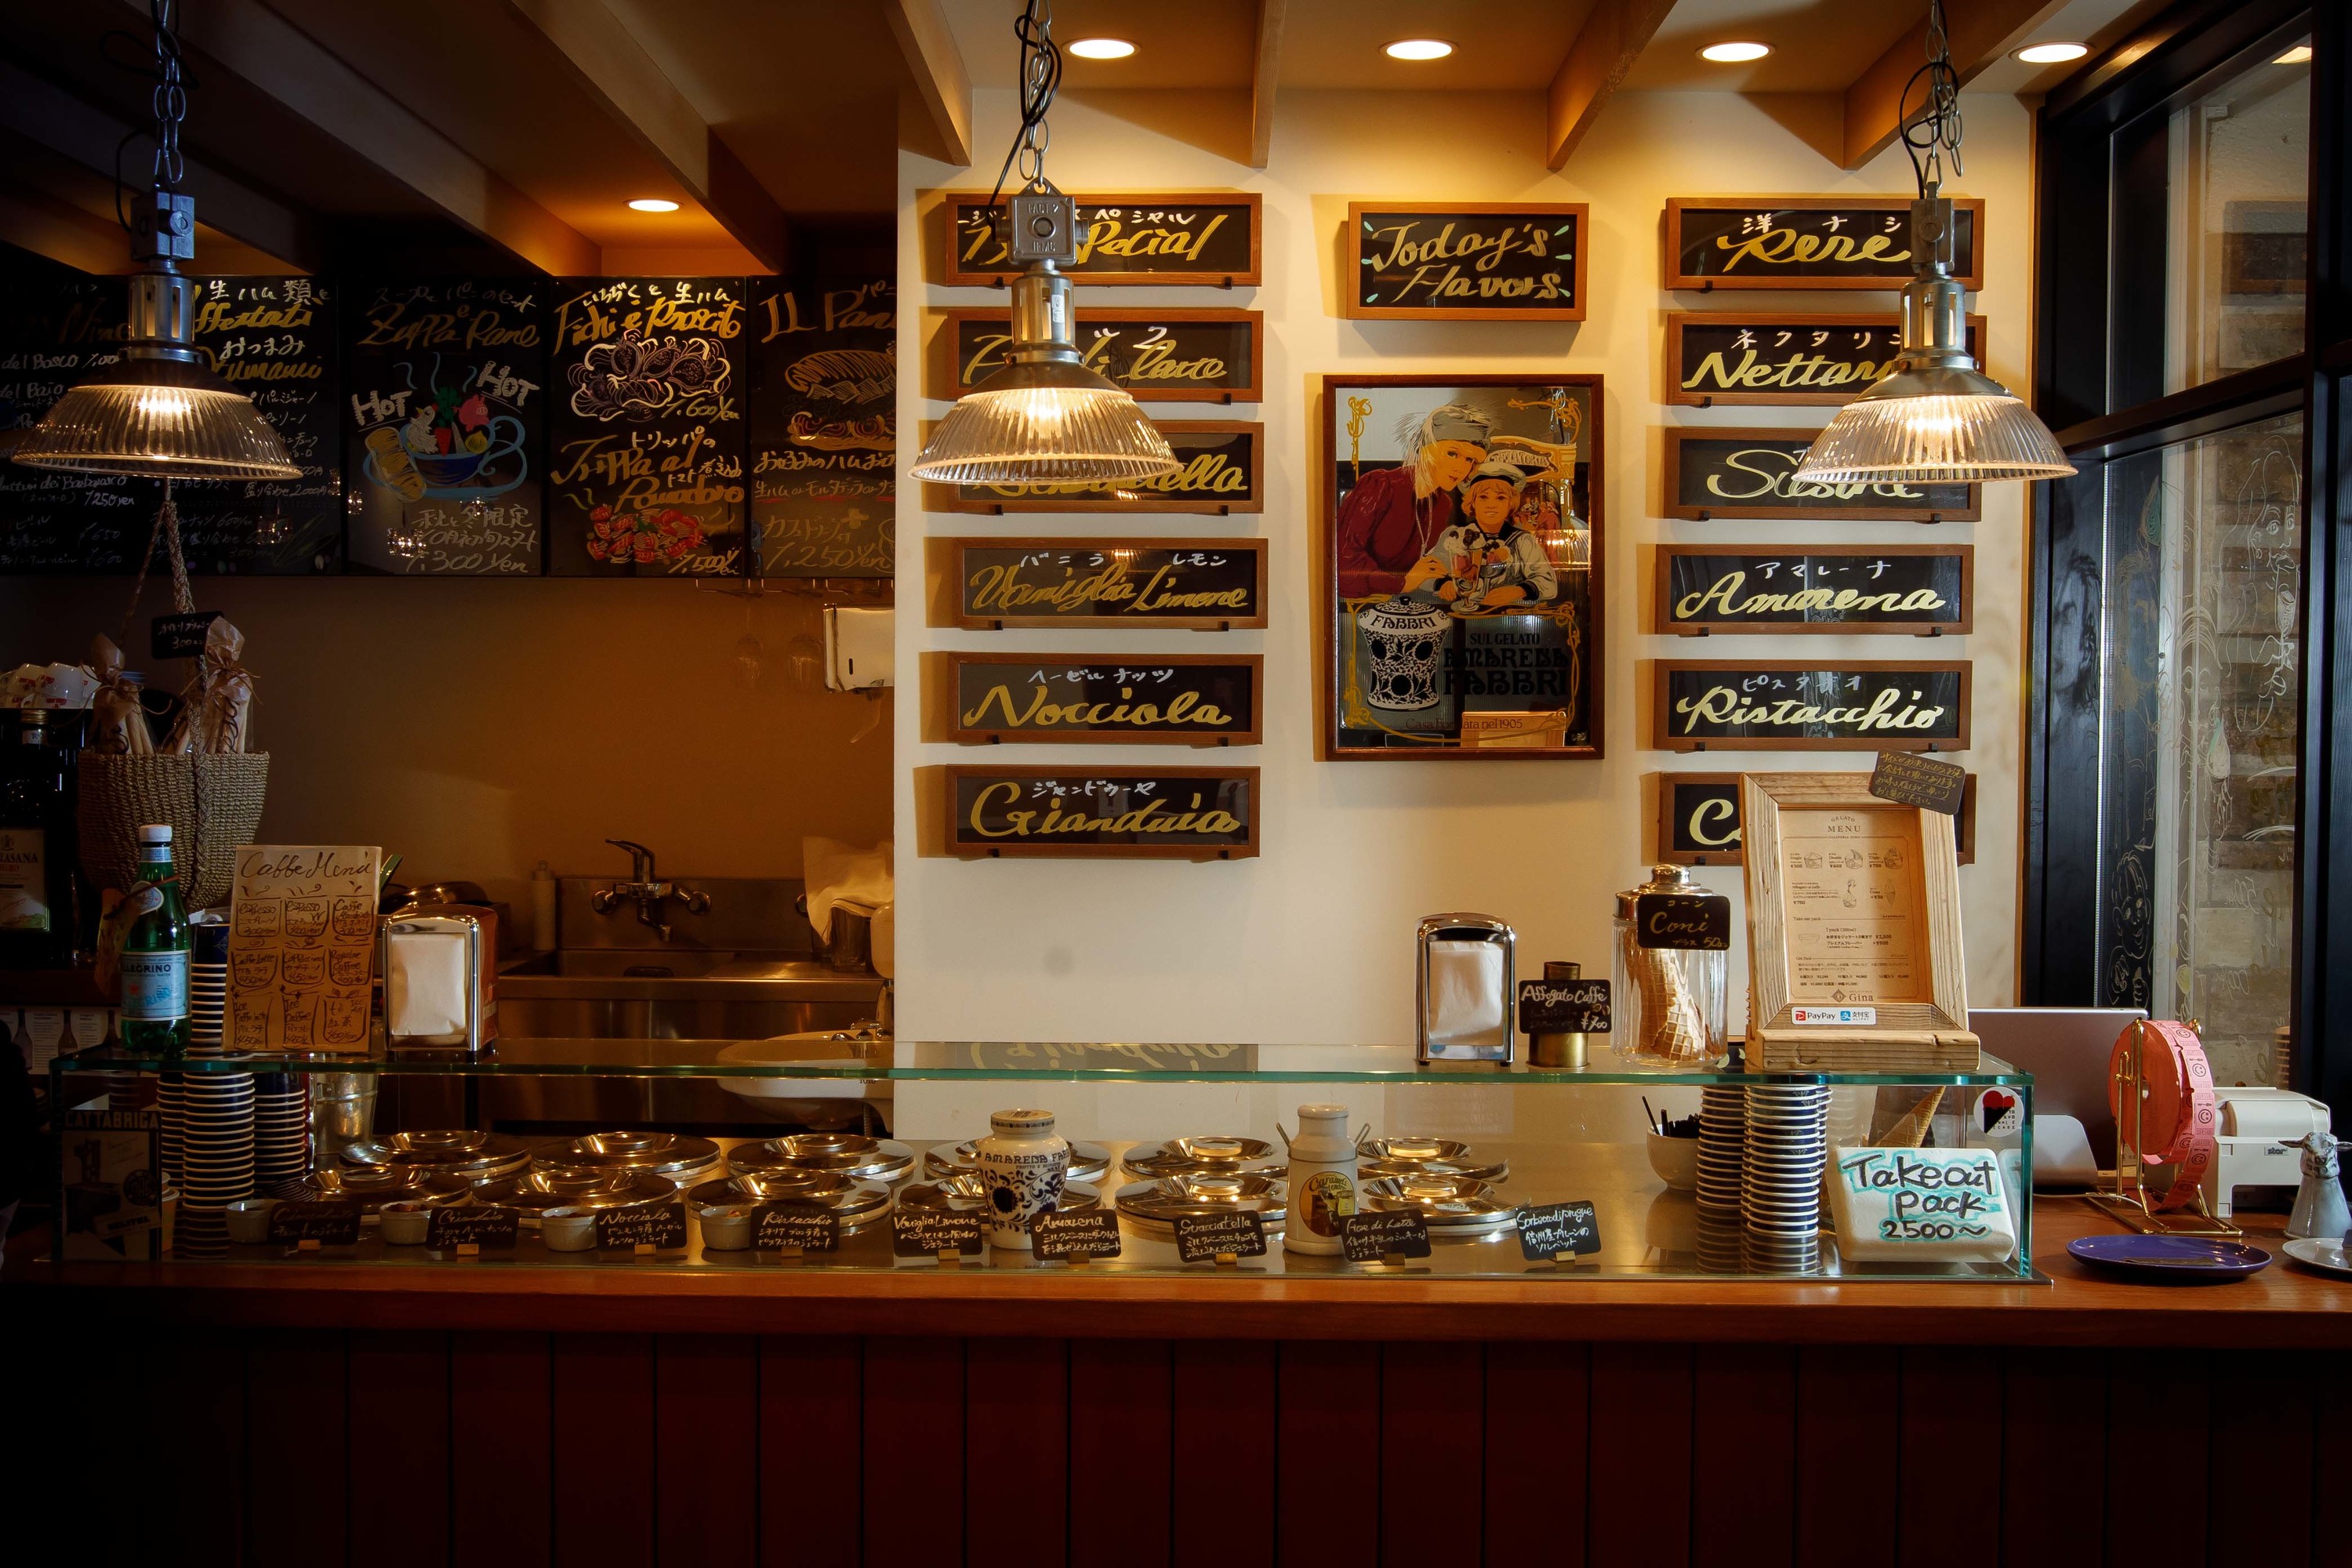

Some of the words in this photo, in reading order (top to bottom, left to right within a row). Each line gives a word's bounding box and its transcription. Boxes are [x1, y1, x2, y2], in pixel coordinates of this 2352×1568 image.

[1371, 221, 1548, 274] Today's
[1392, 264, 1559, 303] Flavors
[194, 292, 322, 333] ffettati
[466, 310, 541, 350] Pane
[219, 335, 306, 361] おつまみ
[477, 361, 540, 406] HOT
[633, 425, 715, 450] トリッパの
[551, 437, 652, 485] Trippa
[1021, 552, 1105, 568] バニラ
[1173, 554, 1228, 567] レモン
[1756, 561, 1891, 579] アマレーナ
[969, 561, 1138, 613] Vaniglia
[1676, 571, 1946, 619] Amarena
[1370, 614, 1437, 630] FABBRI
[1470, 633, 1495, 645] SUL
[1497, 633, 1540, 645] GELATO
[1444, 648, 1567, 669] AMARENA
[1028, 667, 1174, 684] ヘーゼルナッツ
[1443, 670, 1567, 697] FABBRI
[1743, 675, 1862, 691] ピスタチオ
[963, 684, 1233, 727] Nocciola
[1676, 685, 1944, 734] Pistacchio
[1406, 717, 1434, 730] Casa
[1481, 717, 1498, 730] nel
[1499, 718, 1524, 730] 1905
[969, 782, 1242, 837] Gianduia
[1650, 911, 1709, 935] Coni
[1520, 985, 1573, 1008] Affogato
[1849, 993, 1875, 1002] Gina
[1581, 1011, 1608, 1032] ¥700
[985, 1154, 1048, 1164] AMARENA
[1842, 1153, 1996, 1196] Takeout
[1894, 1191, 1987, 1218] Pack
